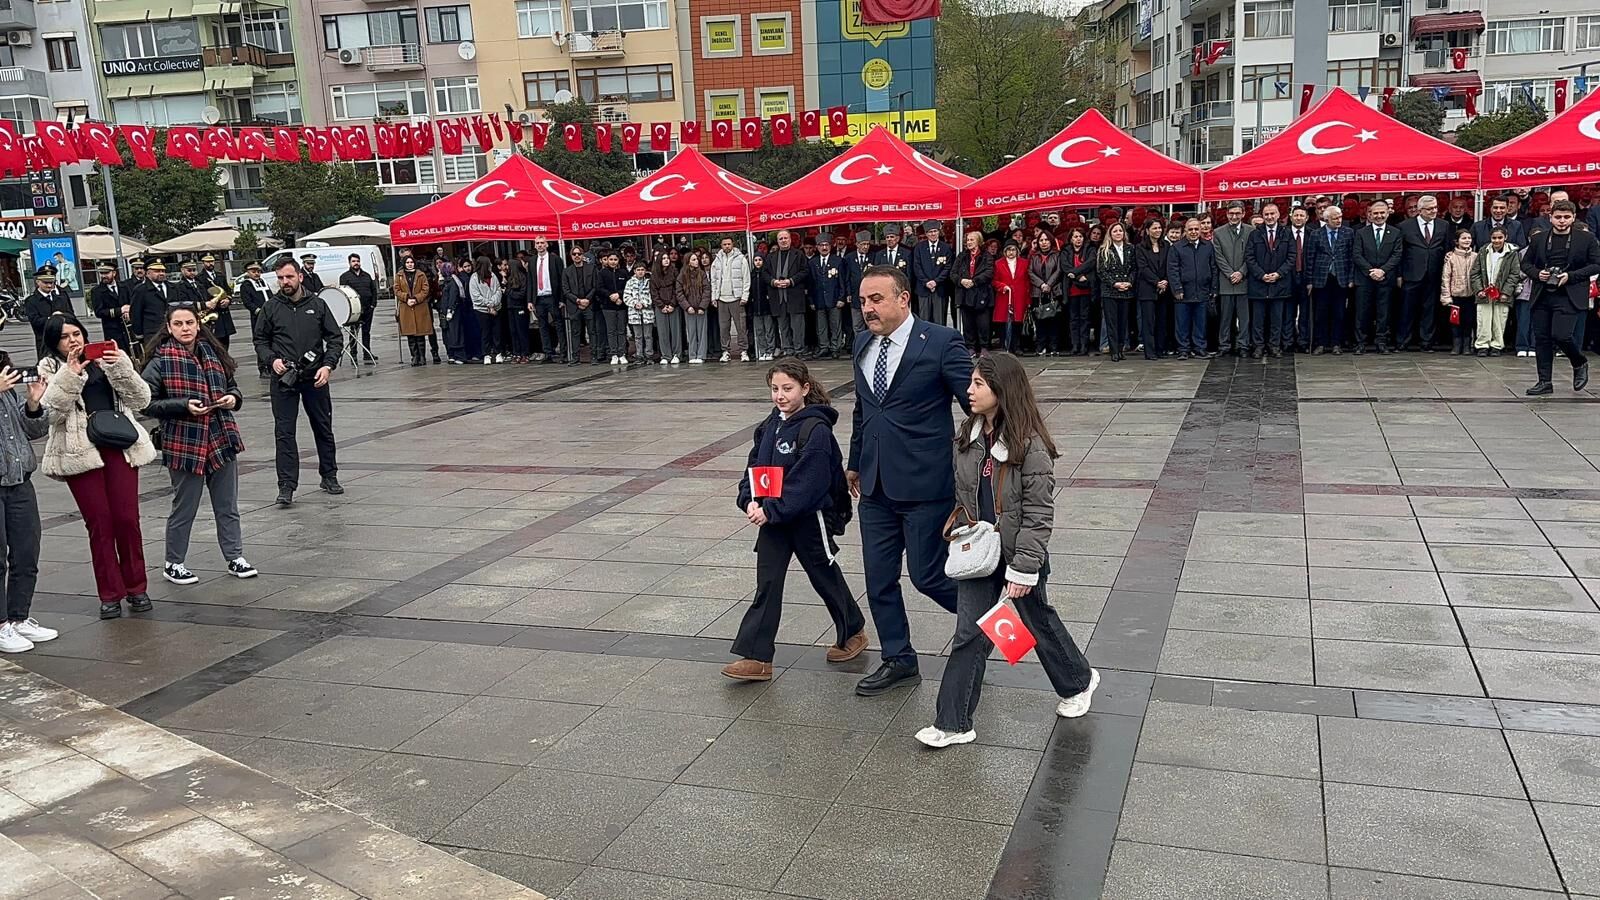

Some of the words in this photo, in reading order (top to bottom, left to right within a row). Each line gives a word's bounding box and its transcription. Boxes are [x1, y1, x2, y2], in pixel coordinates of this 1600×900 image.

[103, 61, 136, 74] UNIQ
[137, 62, 153, 72] Art
[153, 58, 199, 71] Collective
[891, 119, 930, 135] TME
[1517, 163, 1581, 176] KOCAELİ
[1232, 178, 1289, 189] KOCAELİ
[1380, 172, 1460, 181] BELEDİYESİ
[987, 192, 1036, 206] KOCAELİ
[1115, 184, 1186, 193] BELEDİYESİ
[770, 212, 813, 221] KOCAELİ
[581, 221, 620, 230] KOCAELİ
[35, 241, 51, 249] Yeni
